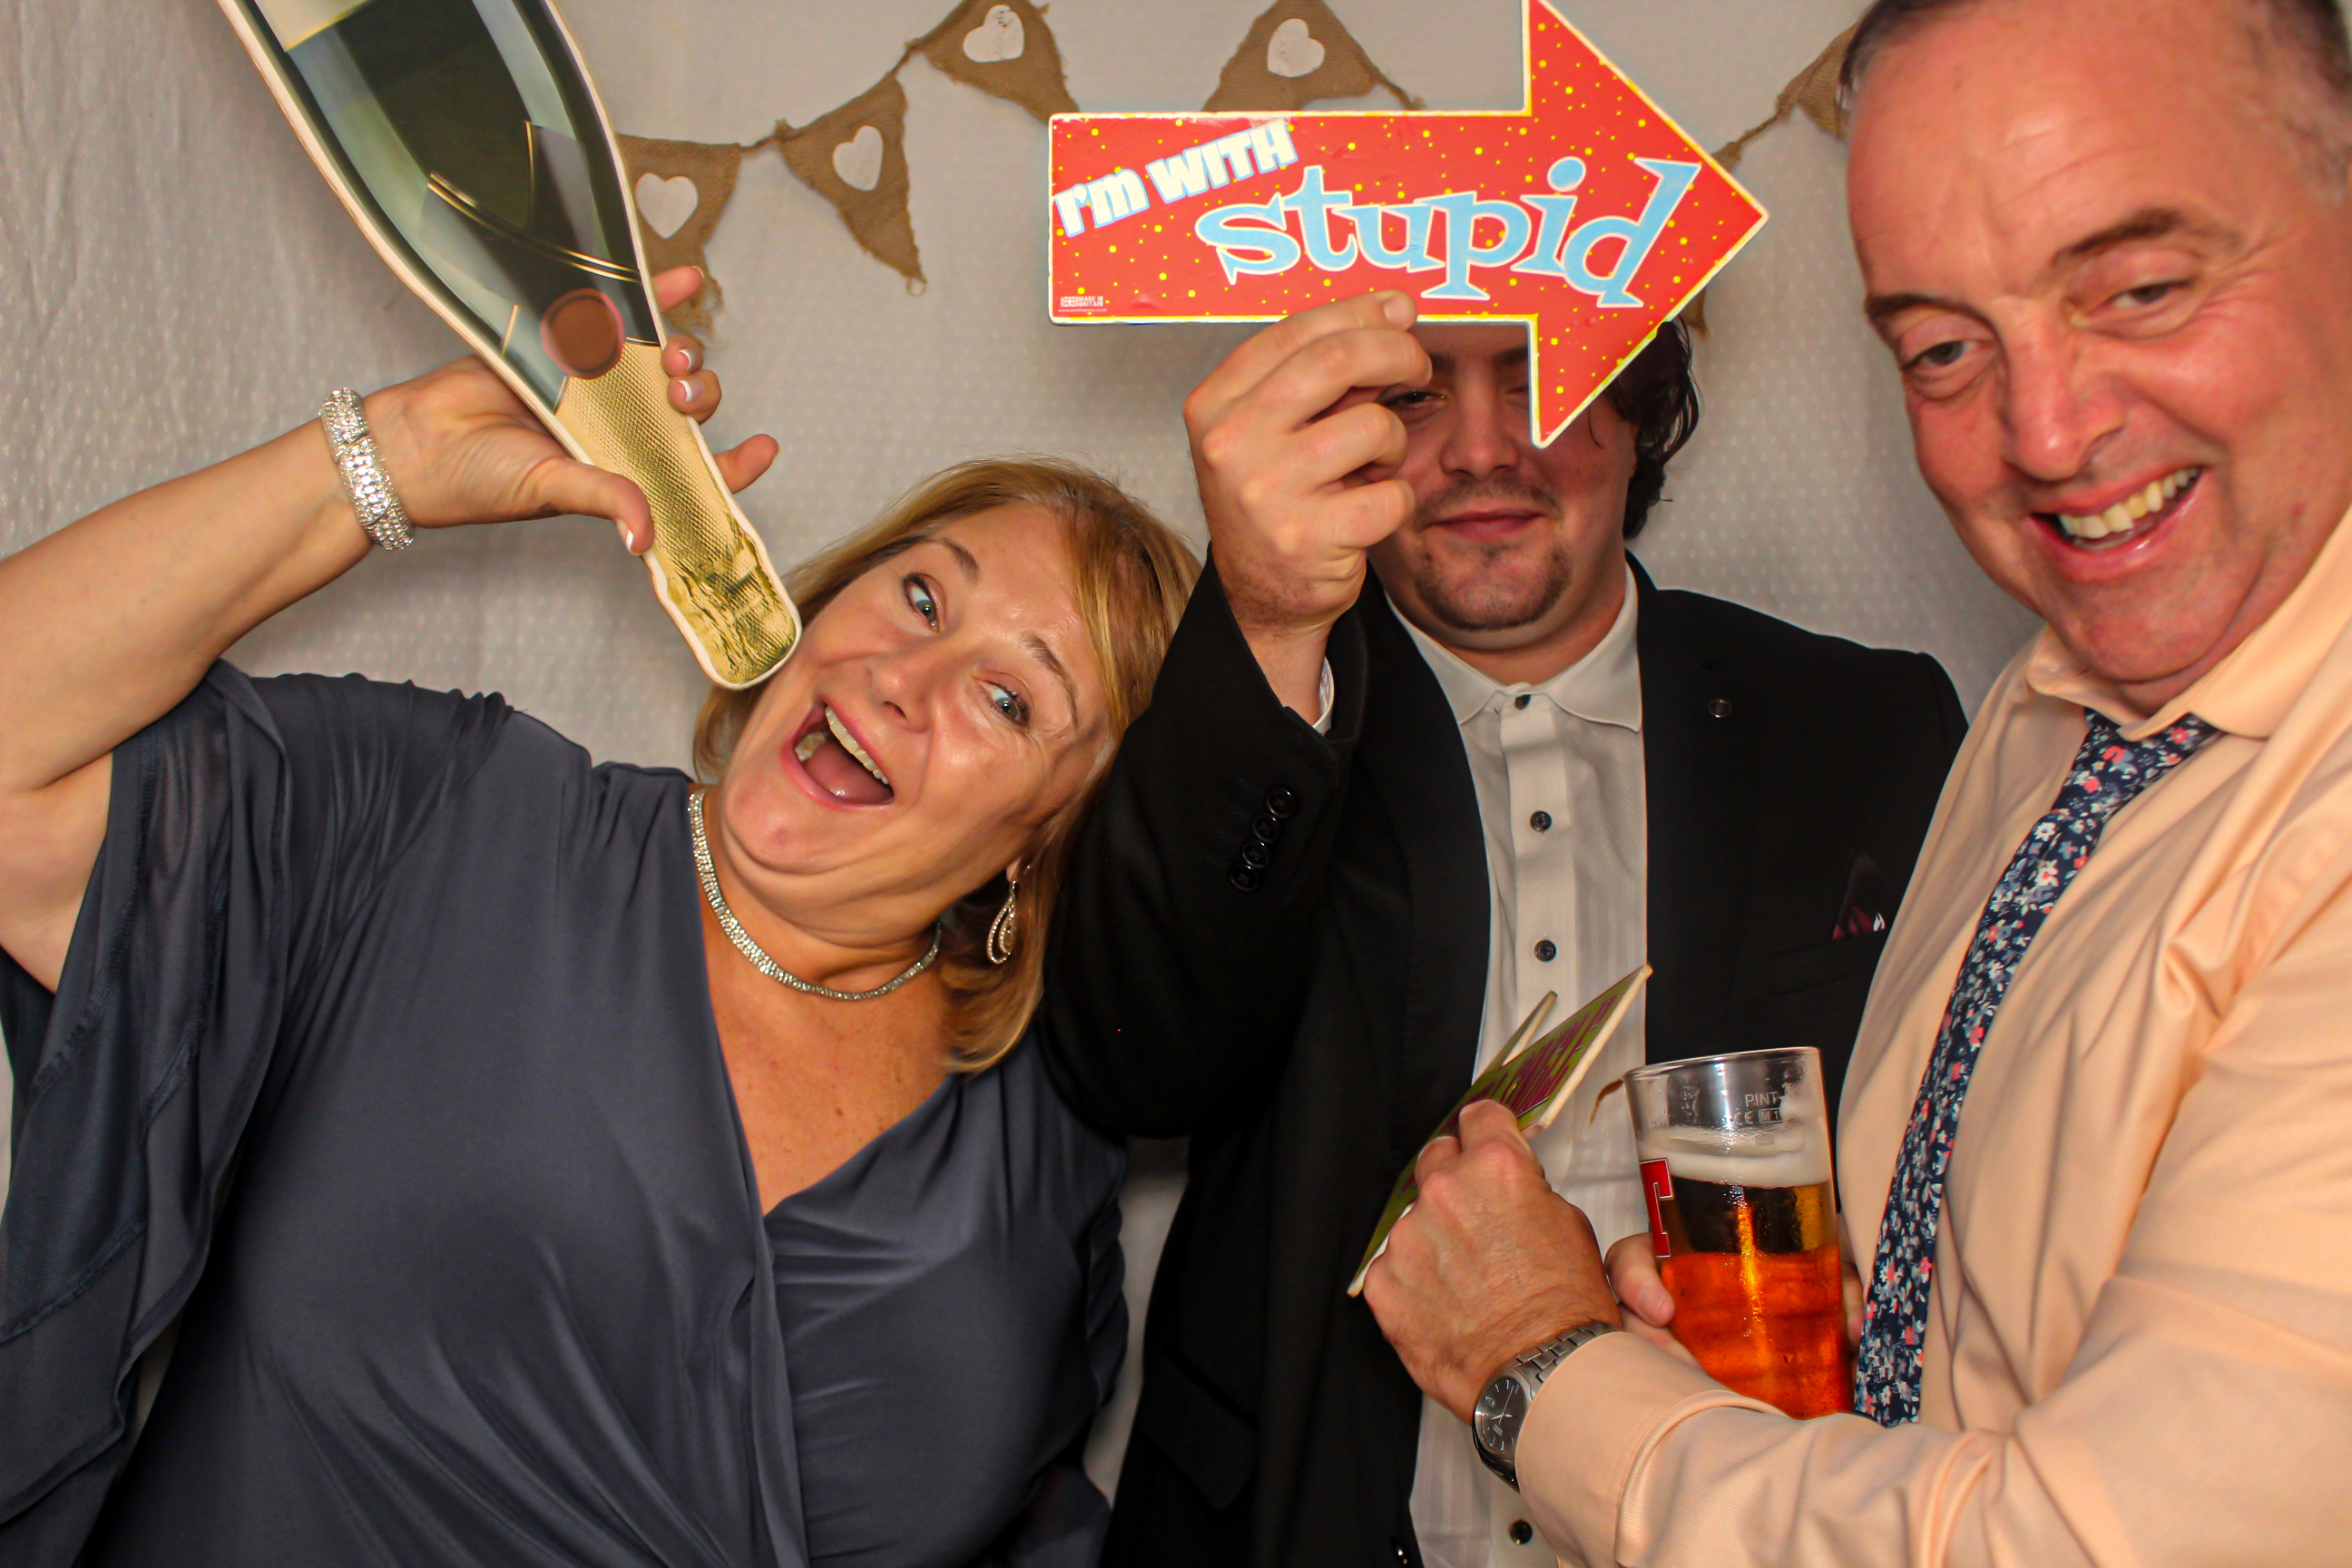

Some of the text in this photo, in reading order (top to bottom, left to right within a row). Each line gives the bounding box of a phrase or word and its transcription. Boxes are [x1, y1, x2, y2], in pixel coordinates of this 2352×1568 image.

[1145, 119, 1298, 204] WITH
[1194, 156, 1702, 308] stupid
[1744, 1091, 1778, 1108] PINT
